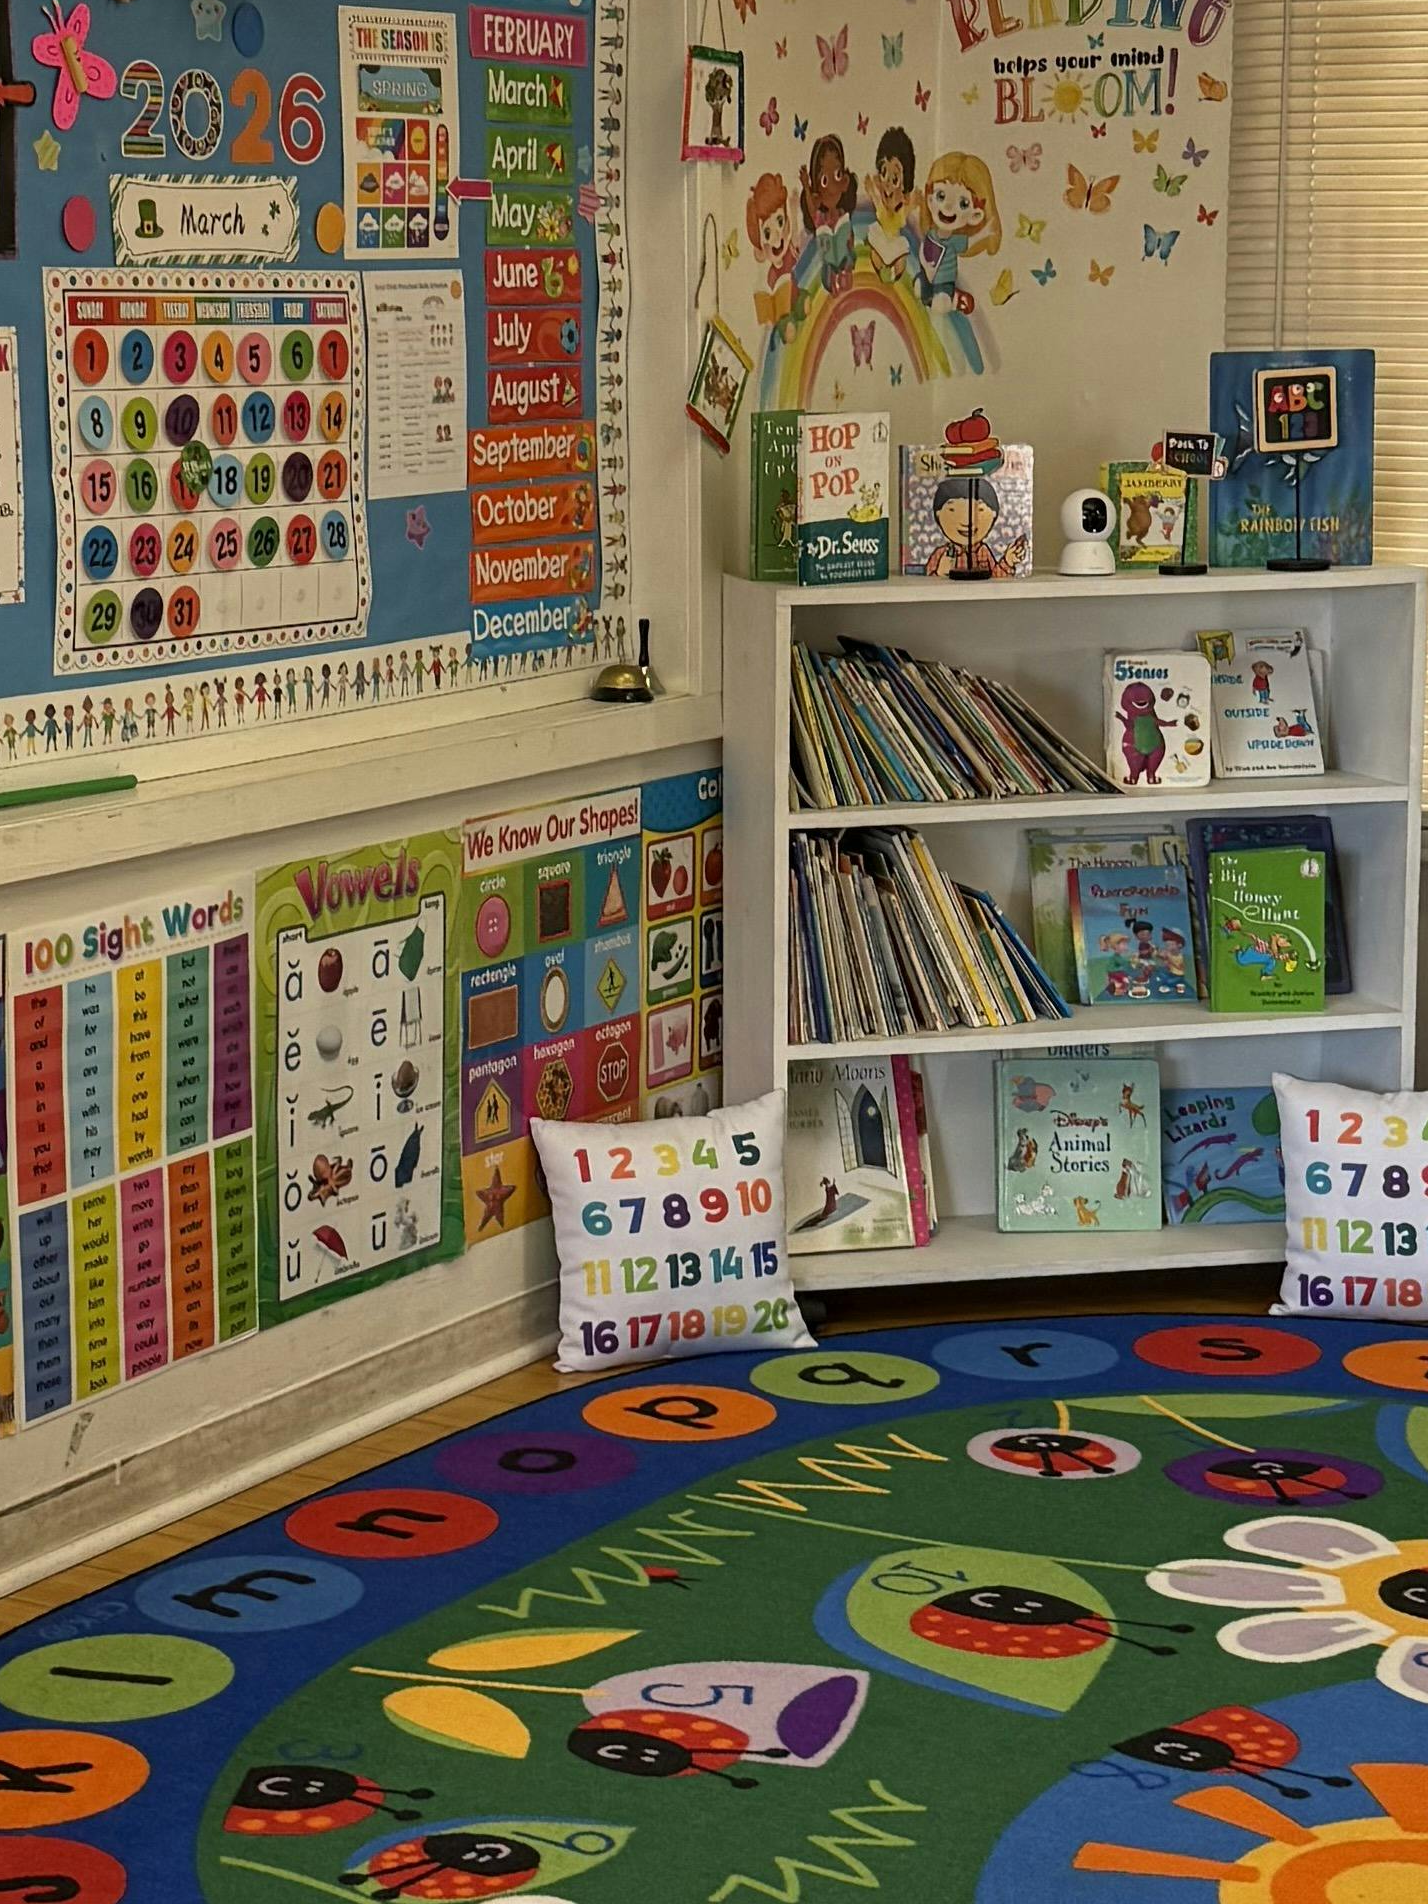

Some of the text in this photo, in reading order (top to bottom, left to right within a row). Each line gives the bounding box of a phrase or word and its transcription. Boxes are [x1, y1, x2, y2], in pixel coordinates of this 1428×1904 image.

[356, 28, 443, 53] THE SEASON IS
[484, 14, 574, 61] FEBRUARY
[994, 45, 1164, 77] helps your mind
[373, 79, 427, 96] SPRING
[488, 74, 548, 108] March
[121, 59, 326, 165] 2026
[492, 137, 537, 174] April
[181, 203, 245, 236] March
[492, 191, 535, 234] May
[493, 256, 538, 289] June
[493, 312, 532, 353] July
[491, 373, 560, 413] August
[1268, 382, 1325, 414] ABC
[764, 420, 795, 436] Ten
[808, 422, 861, 453] HOP
[472, 429, 575, 469] September
[825, 455, 842, 469] ON
[810, 468, 861, 499] POP
[477, 492, 556, 527] October
[1252, 504, 1271, 516] THE
[1310, 516, 1340, 532] FISH
[818, 531, 880, 559] Dr. Seuss
[476, 549, 568, 584] November
[474, 606, 570, 640] December
[1114, 660, 1127, 681] 5
[1126, 666, 1169, 680] Senses
[1224, 708, 1270, 718] OUTSIDE
[467, 796, 638, 861] We Know Our Shapes!
[597, 846, 631, 865] triangle
[294, 846, 421, 922] Vowels
[538, 860, 571, 881] square
[1221, 869, 1247, 886] Big
[480, 876, 506, 893] circle
[1234, 890, 1283, 906] Honey
[1262, 907, 1300, 922] Hunt
[25, 890, 244, 974] 100 Sight Words
[545, 948, 565, 968] oval
[470, 965, 516, 988] rectangle
[595, 1022, 631, 1042] octagon
[533, 1038, 575, 1060] hexagon
[468, 1056, 517, 1083] pentagon
[600, 1060, 628, 1082] STOP
[832, 1063, 886, 1081] Moons
[1050, 1109, 1108, 1132] Disney's
[1164, 1095, 1235, 1122] Leaping
[1164, 1113, 1227, 1143] Lizards
[1049, 1132, 1111, 1153] Animal
[1050, 1152, 1110, 1173] Stories
[581, 1178, 773, 1235] 6 7 8 9 10
